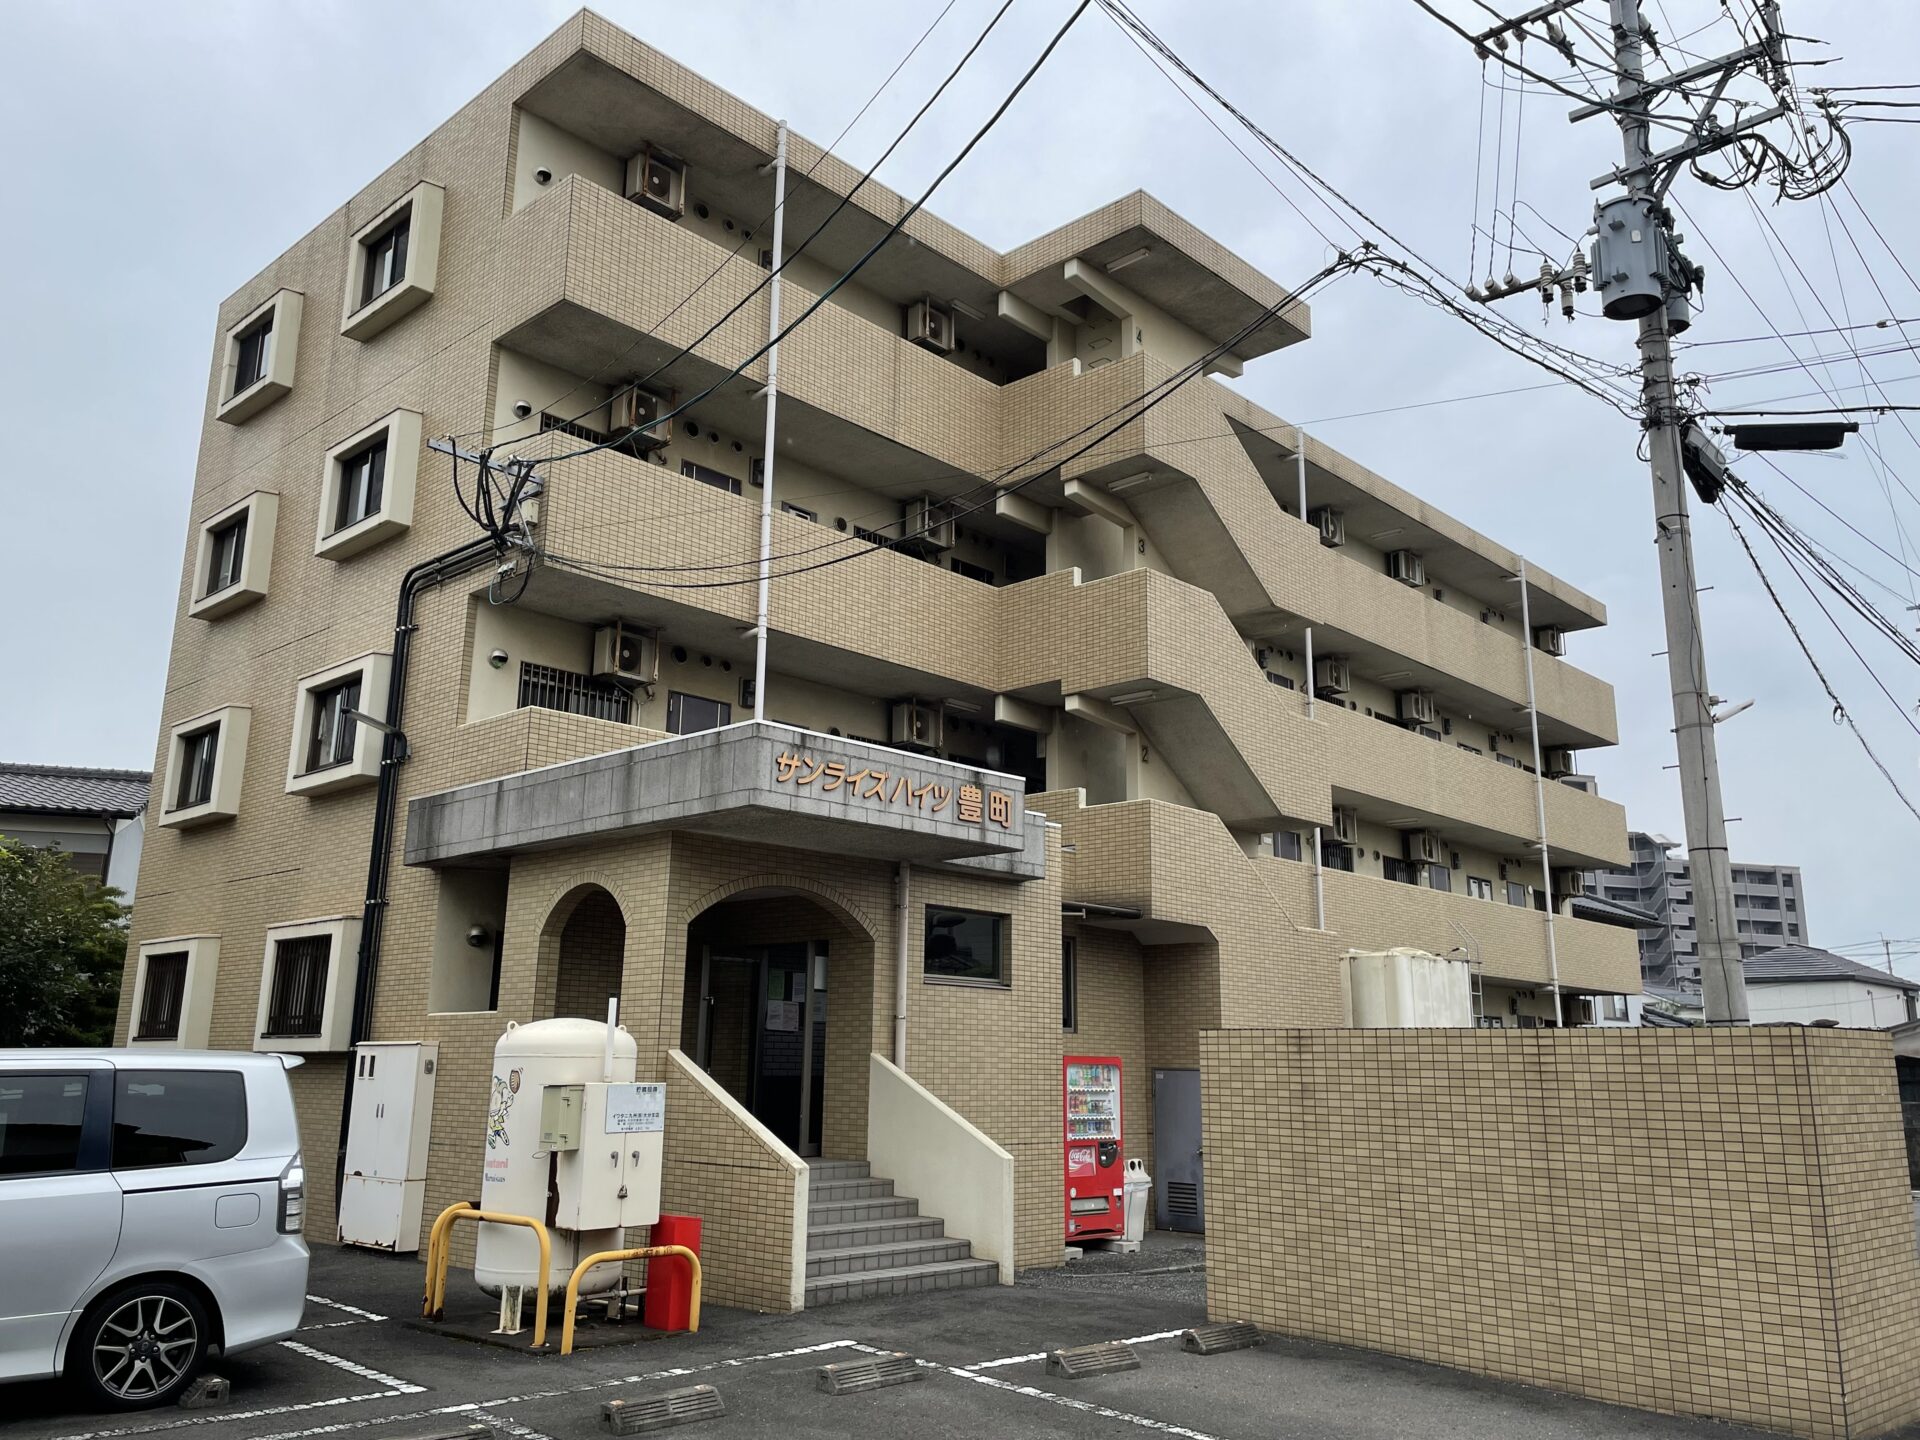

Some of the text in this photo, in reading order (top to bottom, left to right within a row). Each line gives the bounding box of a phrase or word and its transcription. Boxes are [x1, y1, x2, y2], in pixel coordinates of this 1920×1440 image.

[1136, 329, 1142, 343] 4
[1138, 539, 1145, 554] 3
[1141, 746, 1149, 763] 2
